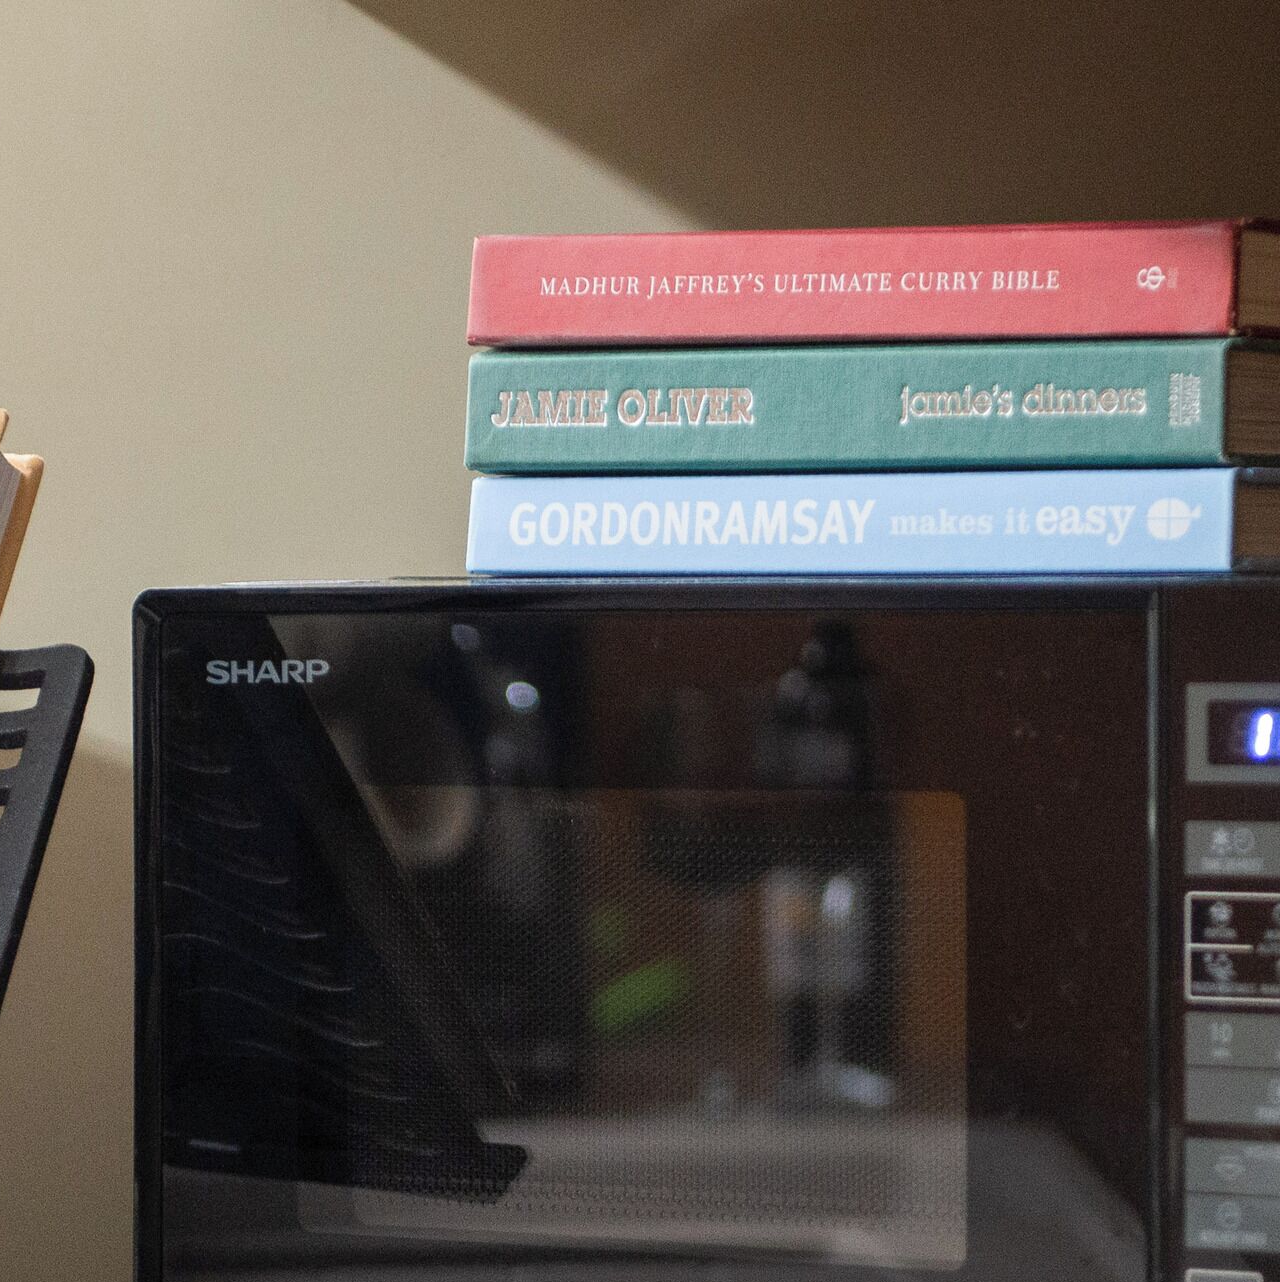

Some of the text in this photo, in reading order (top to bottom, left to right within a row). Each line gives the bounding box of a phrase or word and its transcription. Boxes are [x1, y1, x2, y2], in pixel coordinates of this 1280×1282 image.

[540, 269, 1061, 299] MADHUR JAFFREY'S ULTIMATE CURRY BIBLE
[491, 387, 754, 427] JAMIE OLIVER
[899, 384, 1014, 426] jamie's
[1022, 383, 1147, 416] dinners
[889, 507, 994, 537] makes
[1004, 507, 1030, 536] it
[1035, 497, 1136, 547] easy
[206, 659, 330, 685] SHARP
